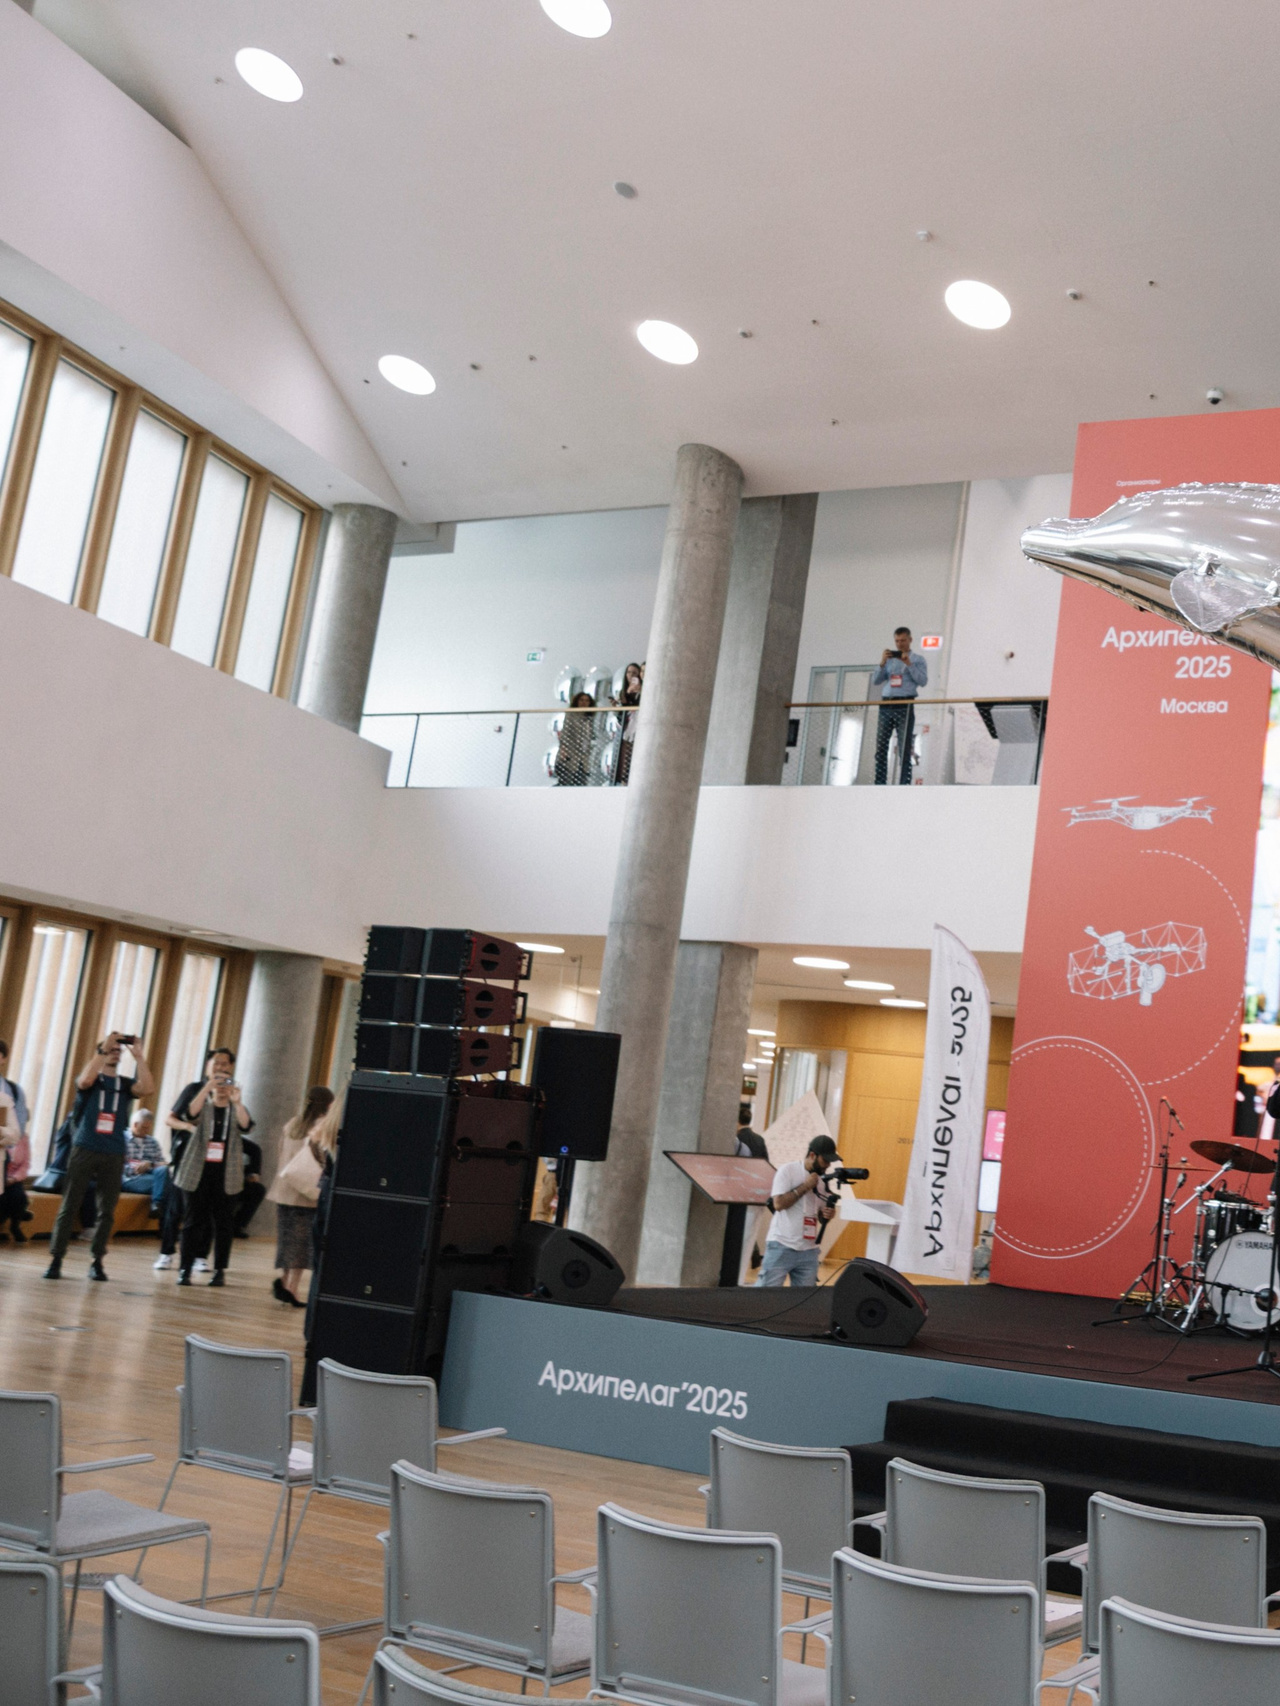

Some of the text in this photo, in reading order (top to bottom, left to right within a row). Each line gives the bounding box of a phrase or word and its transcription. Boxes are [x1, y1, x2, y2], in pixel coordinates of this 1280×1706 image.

[1101, 627, 1223, 652] Архипел
[1175, 655, 1232, 679] 2025
[1160, 698, 1228, 714] Москва
[1244, 1240, 1273, 1249] YAMAHA
